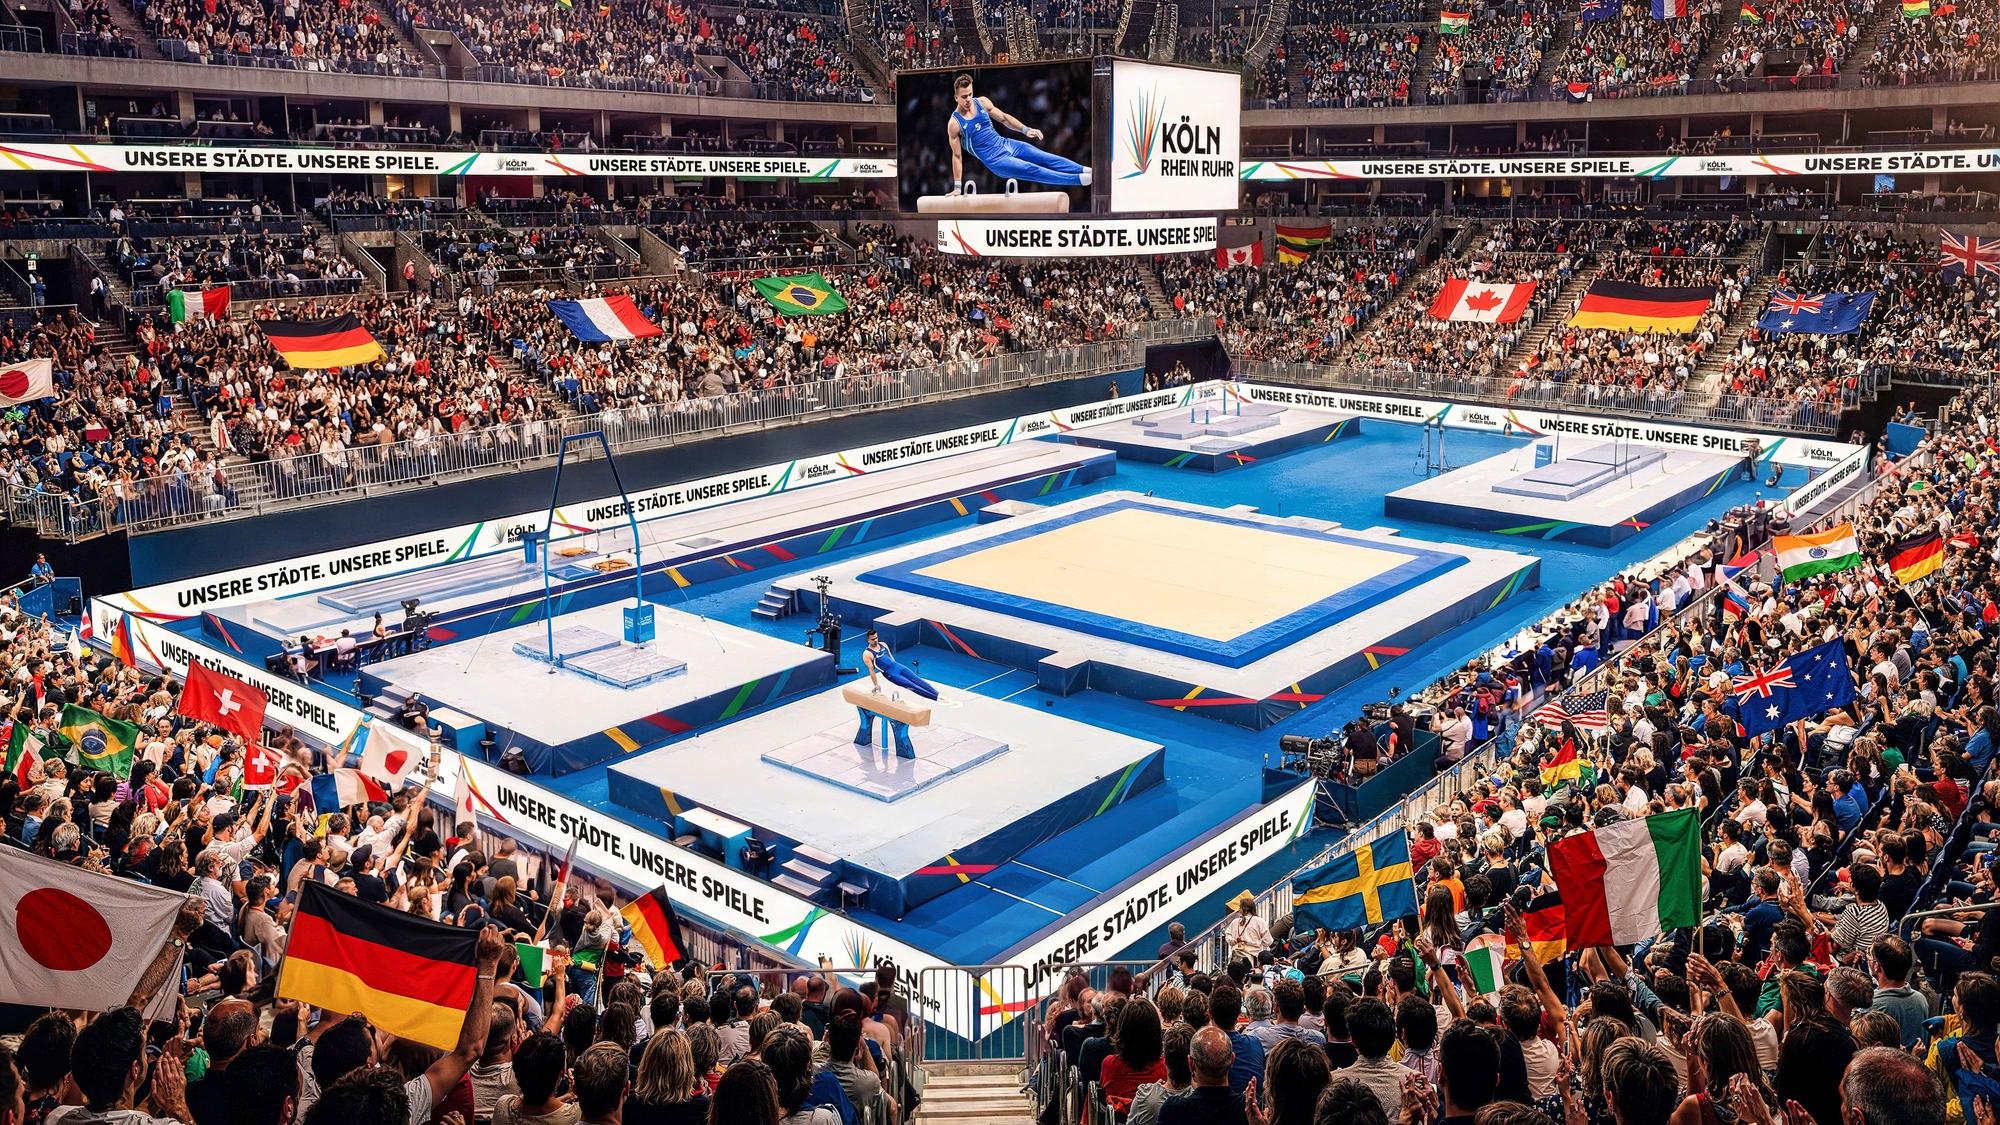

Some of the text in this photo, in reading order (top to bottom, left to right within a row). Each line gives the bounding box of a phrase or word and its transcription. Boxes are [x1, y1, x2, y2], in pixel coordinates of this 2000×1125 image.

[1161, 115, 1221, 155] KÖLN
[124, 149, 440, 171] UNSERE STÄDTE. UNSERE SPIELE.
[589, 157, 811, 174] UNSERE STÄDTE. UNSERE SPIELE.
[1161, 159, 1234, 177] RHEIN RUHR
[1361, 160, 1635, 175] UNSERE STÄDTE. UNSERE SPIELE.
[1804, 156, 1884, 172] UNSERE
[1887, 152, 1971, 170] STÄDTE.
[986, 230, 1053, 248] UNSERE
[1057, 225, 1133, 248] STÄDTE.
[1136, 227, 1191, 247] UNSERE
[1070, 409, 1097, 424] UNSERE
[1125, 398, 1152, 413] UNSERE
[1153, 393, 1178, 408] SPIELE.
[1250, 388, 1425, 418] UNSERE STÄDTE. UNSERE SPIELE.
[1539, 418, 1589, 435] UNSERE
[1591, 422, 1643, 441] STÄDTE.
[1645, 430, 1698, 446] UNSERE
[862, 428, 999, 466] UNSERE STÄDTE. UNSERE SPIELE.
[1811, 448, 1833, 457] KÖLN
[808, 464, 829, 474] KÖLN
[587, 475, 772, 522] UNSERE STÄDTE. UNSERE SPIELE.
[507, 523, 536, 537] KÖLN
[177, 539, 450, 608] UNSERE STÄDTE. UNSERE SPIELE.
[295, 698, 340, 734] SPIELE.
[497, 785, 770, 925] UNSERE STÄDTE. UNSERE SPIELE.
[1025, 810, 1292, 989] UNSERE STÄDTE. UNSERE SPIELE.
